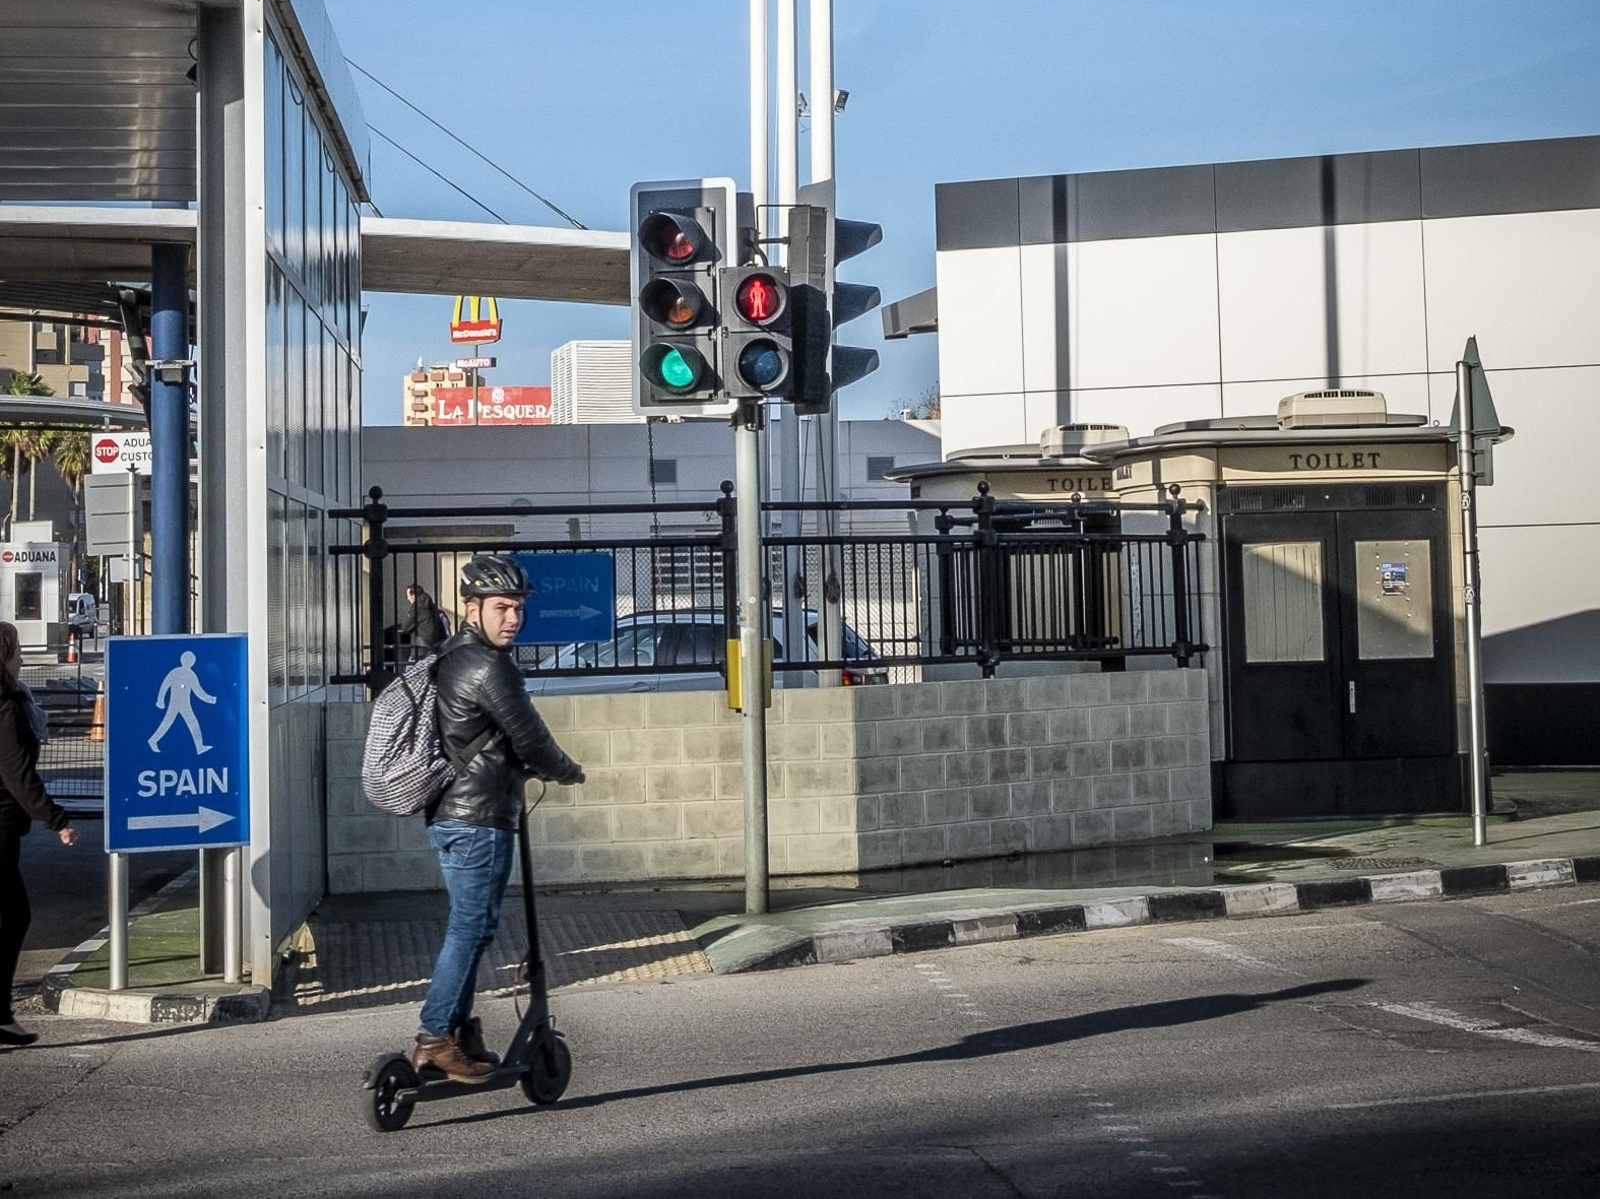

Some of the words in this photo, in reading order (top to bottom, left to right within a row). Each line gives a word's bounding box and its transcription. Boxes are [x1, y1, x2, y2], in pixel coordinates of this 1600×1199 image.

[438, 400, 464, 420] LA
[96, 446, 119, 457] STOP
[1289, 452, 1380, 470] TOILET
[1047, 477, 1112, 492] TOILE
[14, 551, 57, 562] ADUANA
[540, 576, 600, 594] SPAIN
[137, 767, 229, 798] SPAIN
